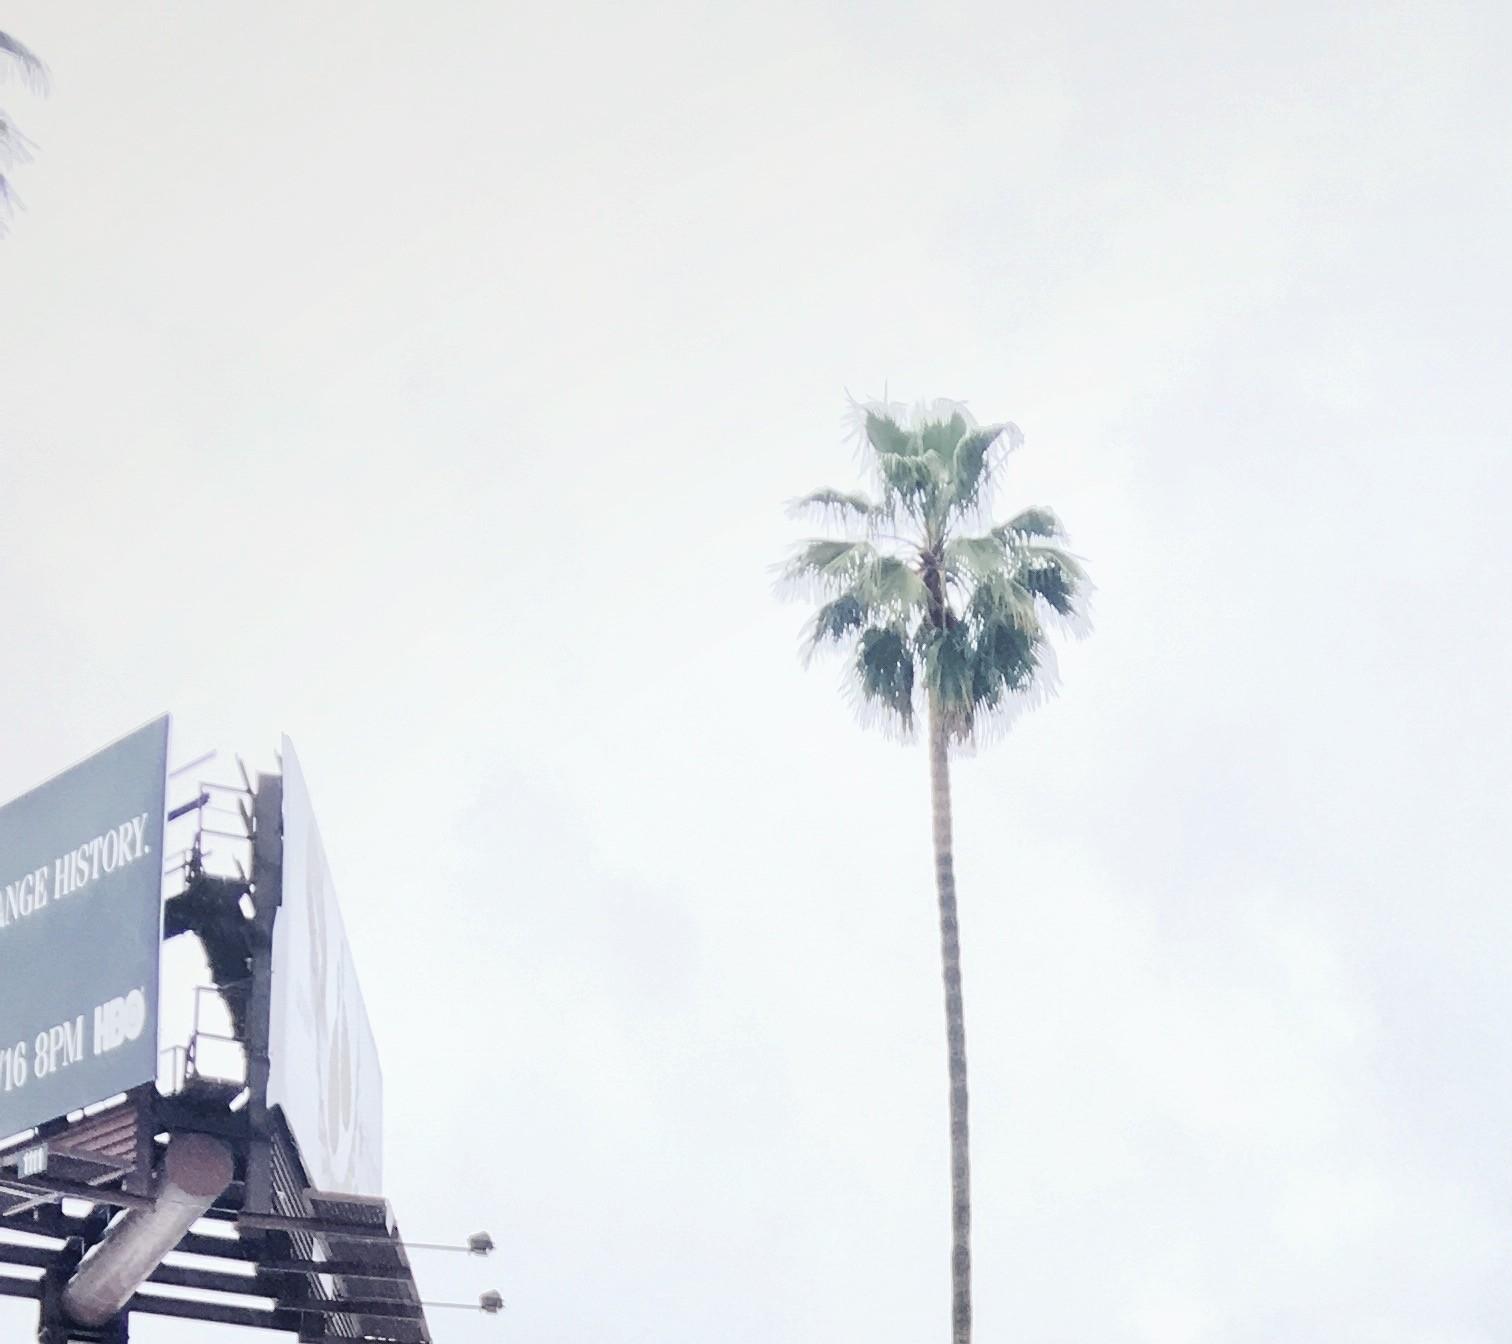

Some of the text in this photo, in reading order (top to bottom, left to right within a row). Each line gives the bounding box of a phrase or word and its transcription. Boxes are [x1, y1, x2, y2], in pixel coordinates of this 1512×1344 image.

[54, 813, 151, 900] HISTORY.
[34, 1014, 85, 1079] 8PM
[94, 987, 146, 1055] HBO
